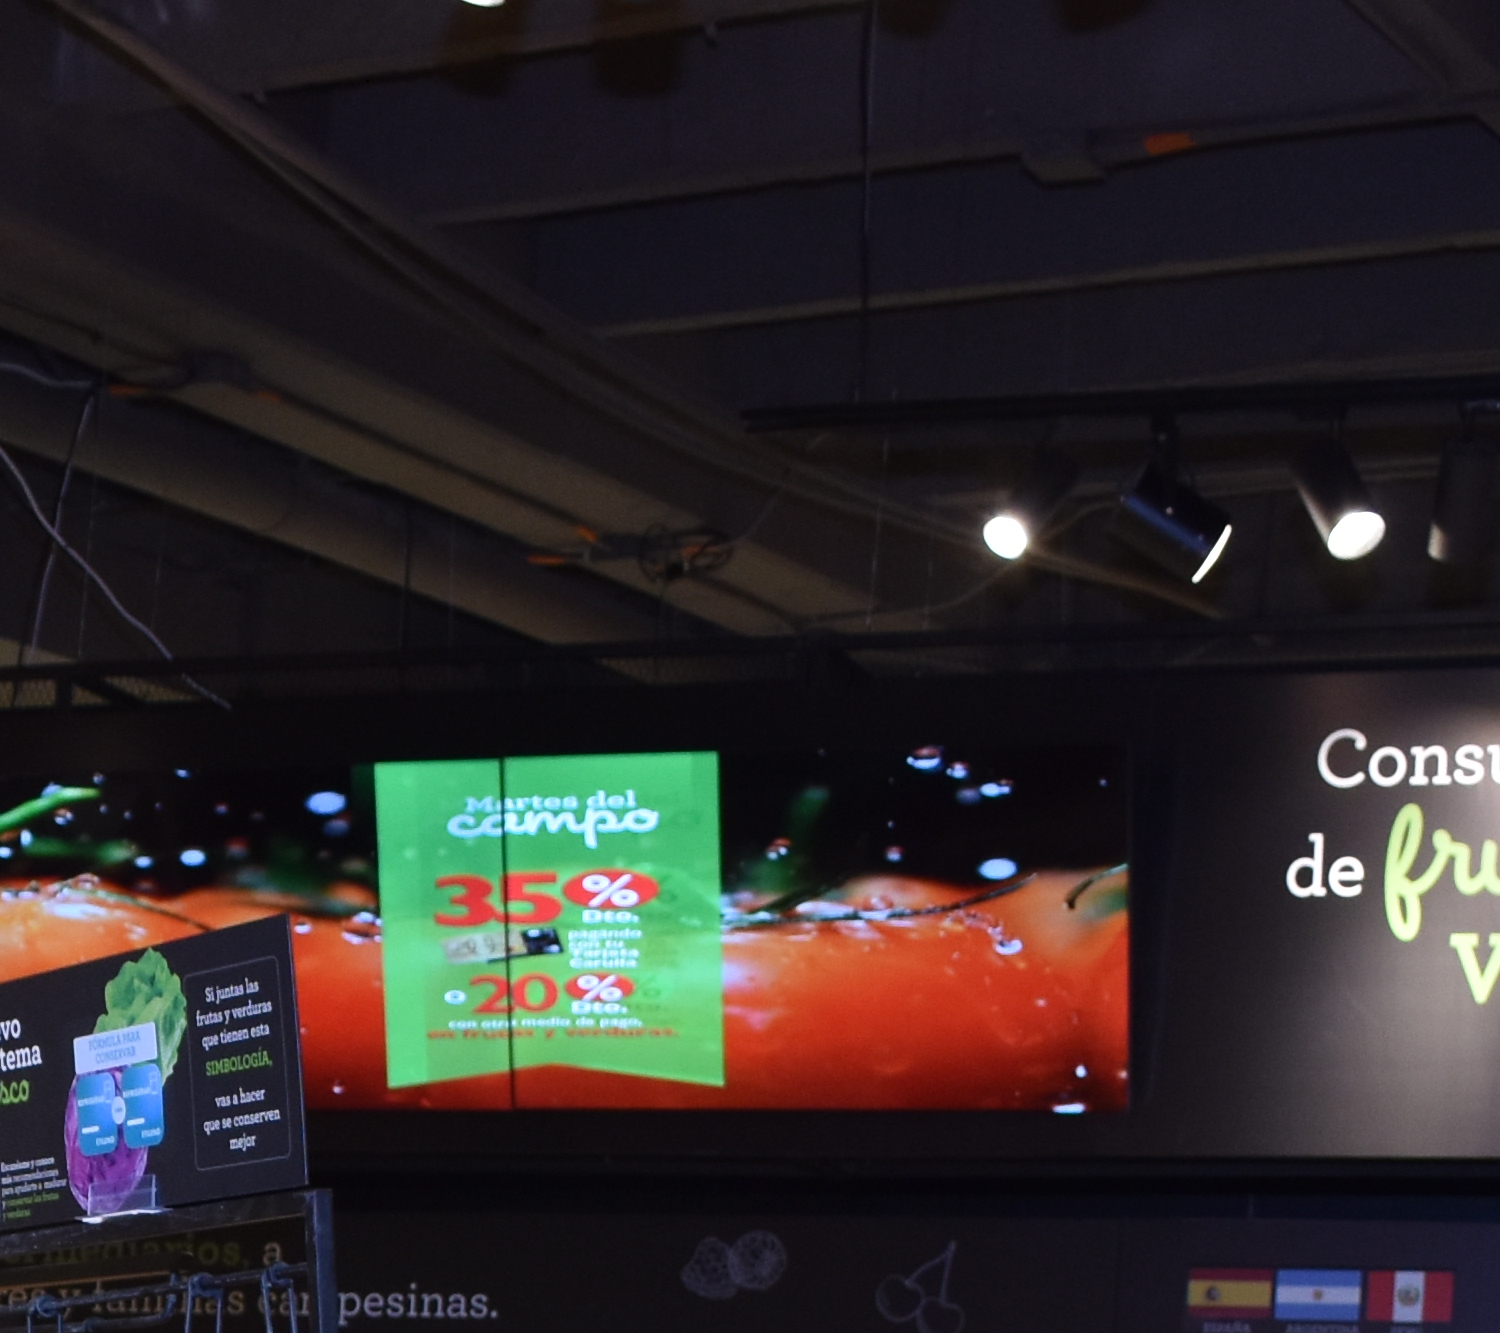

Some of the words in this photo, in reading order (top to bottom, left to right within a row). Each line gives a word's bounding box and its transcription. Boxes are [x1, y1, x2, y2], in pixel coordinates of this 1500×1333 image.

[446, 807, 660, 849] campo
[1285, 832, 1366, 899] de
[215, 983, 244, 1006] juntas
[245, 978, 260, 995] las
[195, 1009, 223, 1028] frutas
[231, 999, 273, 1021] verduras
[201, 1033, 218, 1051] que
[219, 1026, 250, 1044] tienen
[233, 1107, 281, 1129] conserven
